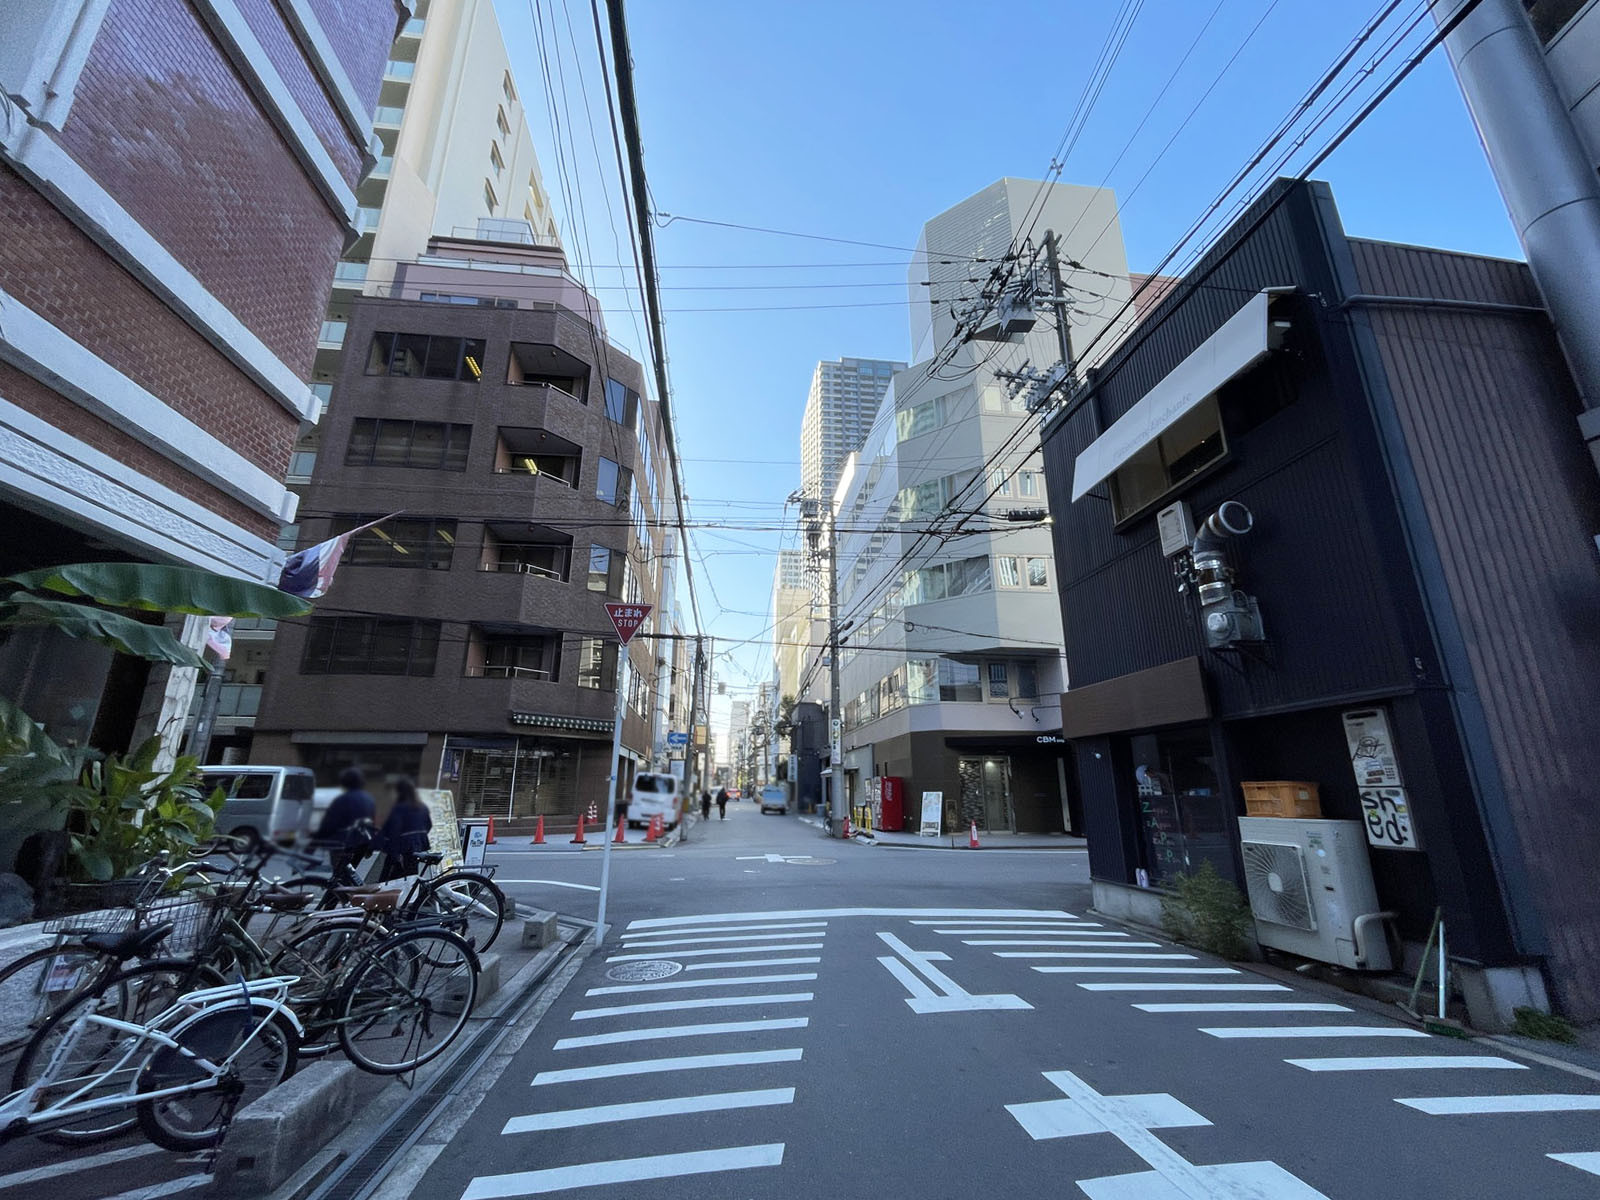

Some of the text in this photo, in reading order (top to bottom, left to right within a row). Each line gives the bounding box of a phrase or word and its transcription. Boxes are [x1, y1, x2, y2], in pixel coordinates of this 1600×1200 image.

[613, 607, 643, 618] 止まれ
[617, 619, 639, 628] STOP
[1036, 735, 1057, 744] CBM
